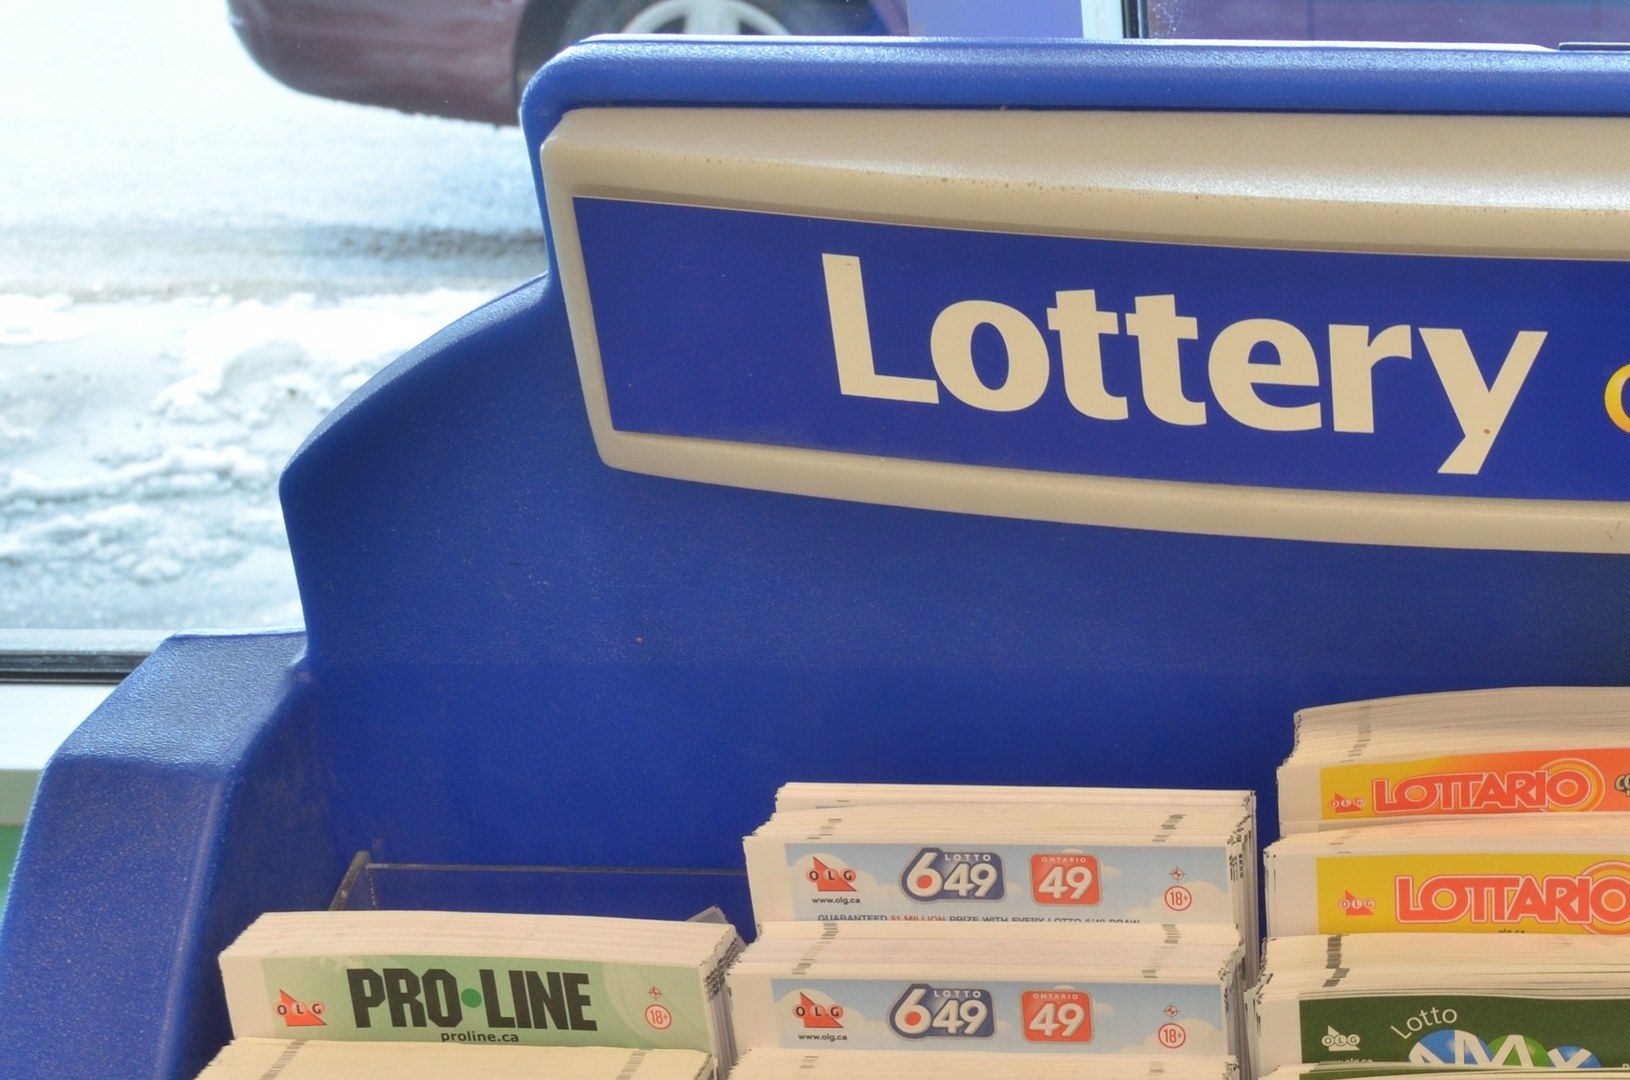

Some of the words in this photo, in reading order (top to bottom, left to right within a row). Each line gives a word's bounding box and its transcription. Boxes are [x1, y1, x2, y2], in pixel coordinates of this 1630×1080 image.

[822, 253, 1548, 475] Lottery
[1372, 763, 1600, 813] LOTTARIO
[441, 1030, 519, 1043] proline.ca
